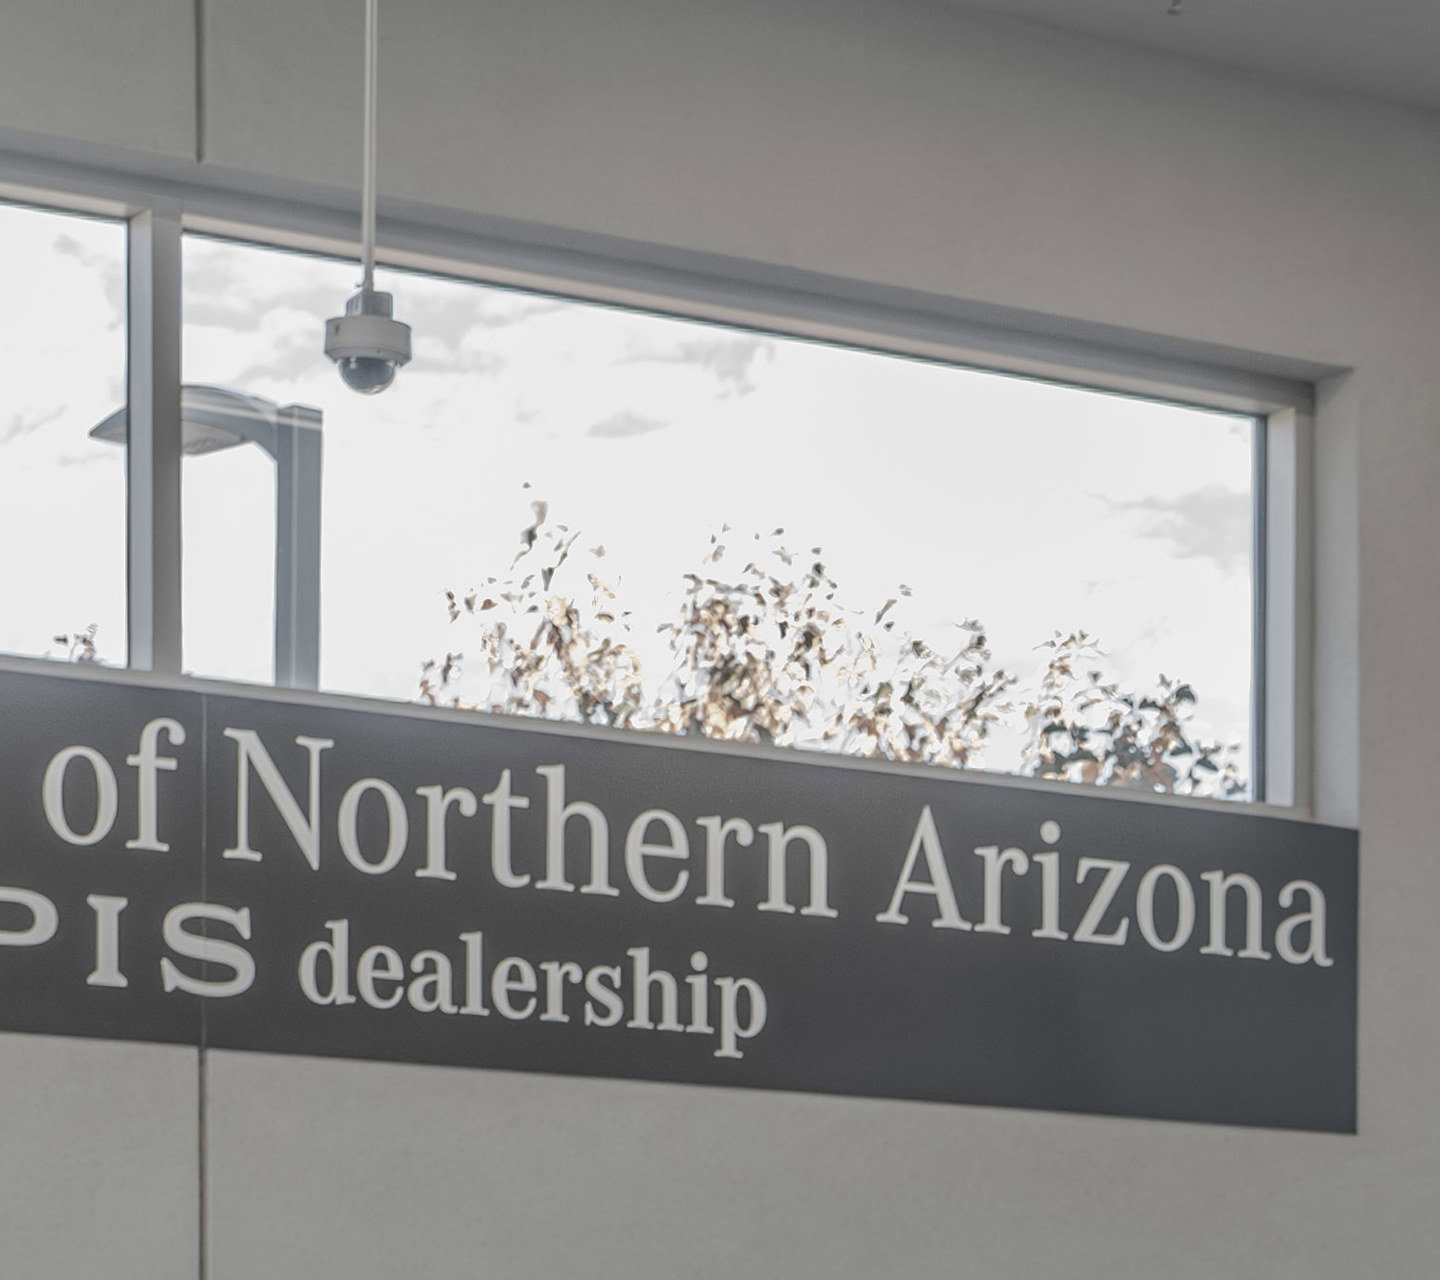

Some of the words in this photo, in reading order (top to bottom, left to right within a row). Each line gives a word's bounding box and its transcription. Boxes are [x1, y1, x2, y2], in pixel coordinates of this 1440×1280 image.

[42, 717, 187, 853] of
[222, 726, 839, 919] Northern
[875, 804, 1334, 967] Arizona
[299, 918, 767, 1059] dealership
